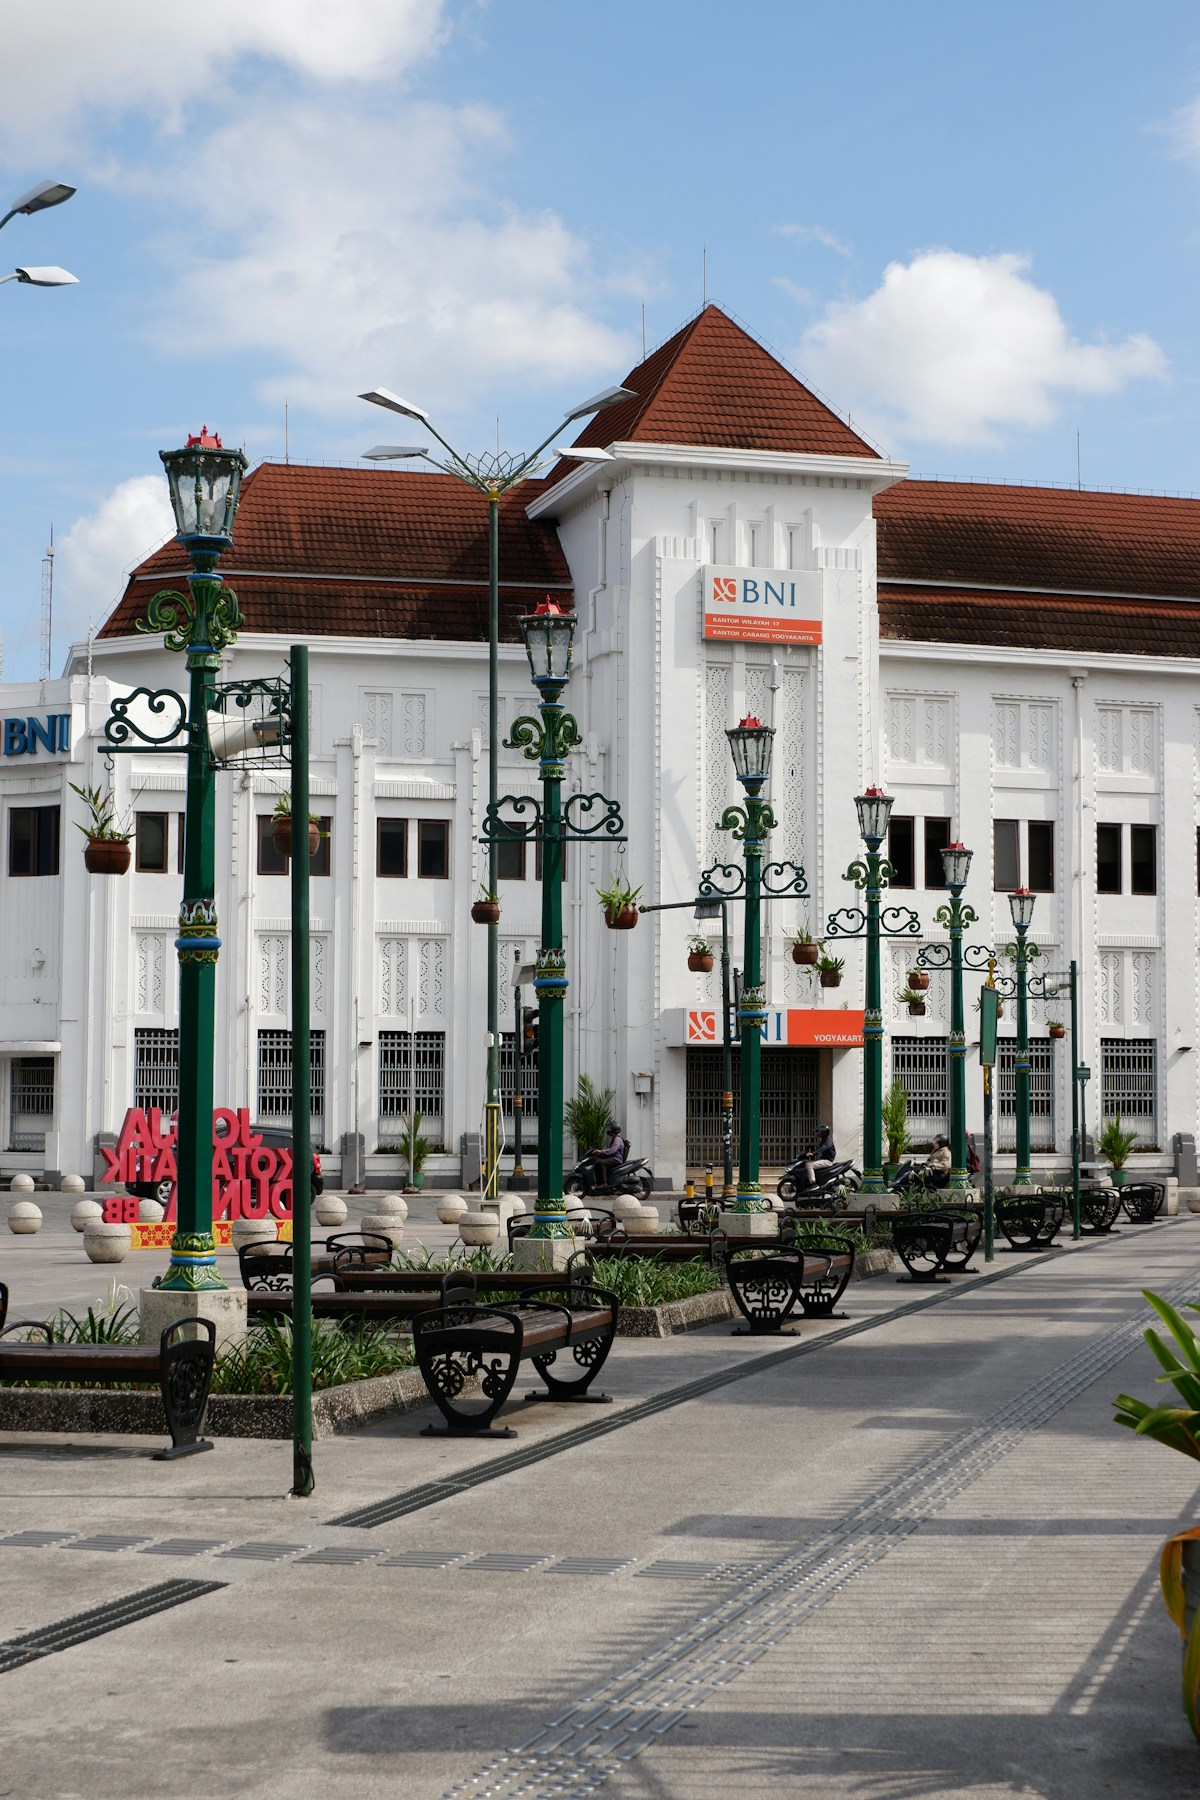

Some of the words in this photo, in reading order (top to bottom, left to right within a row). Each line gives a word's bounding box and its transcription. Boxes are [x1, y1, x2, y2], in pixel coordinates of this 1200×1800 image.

[742, 579, 797, 606] BNI
[712, 629, 740, 637] KANTOR
[743, 631, 770, 639] CABANG
[771, 633, 814, 641] YOGYAKARTA
[3, 714, 71, 755] BNI
[814, 1034, 864, 1042] YOGYAKART
